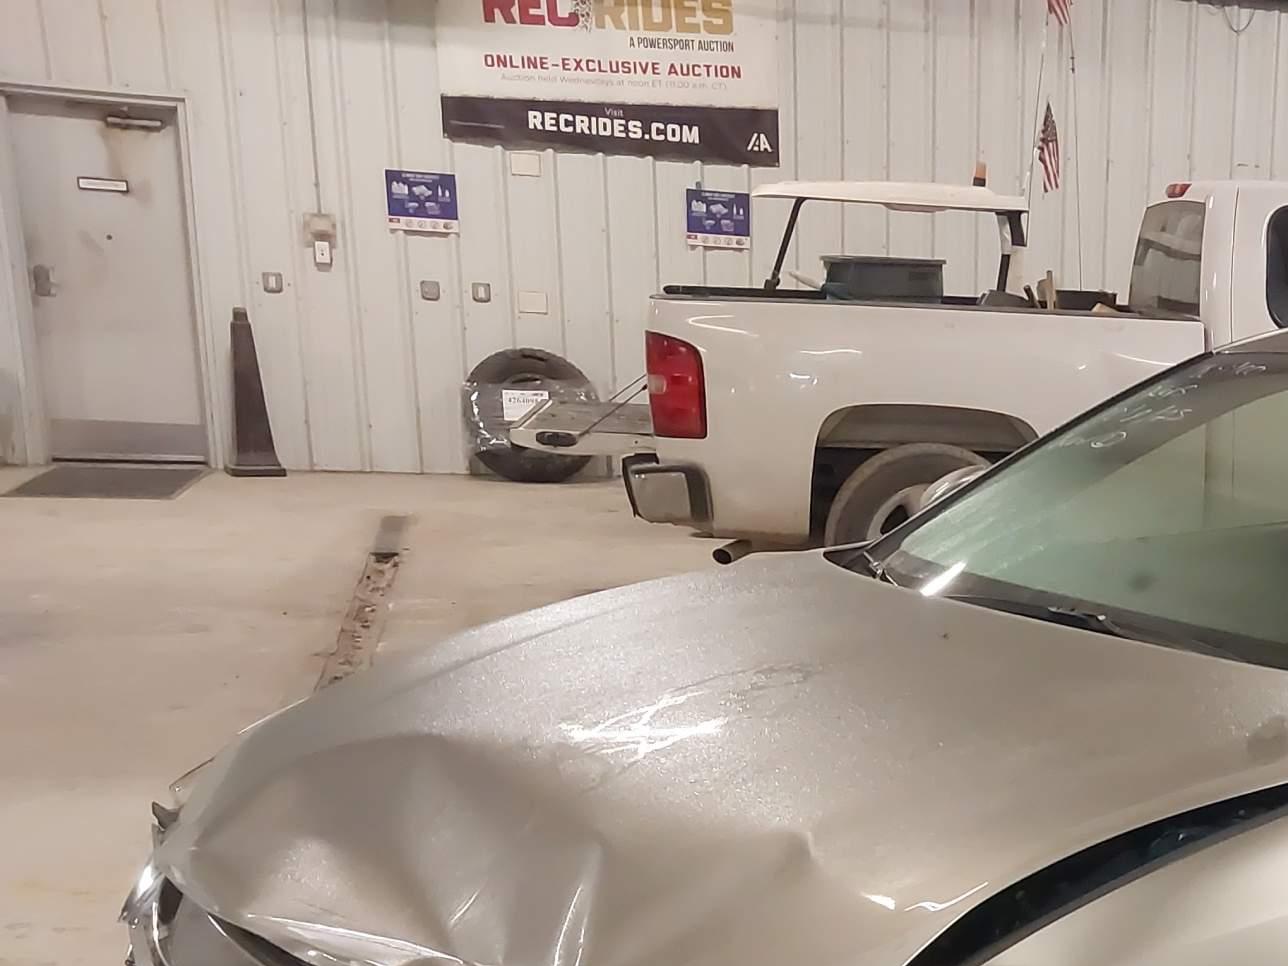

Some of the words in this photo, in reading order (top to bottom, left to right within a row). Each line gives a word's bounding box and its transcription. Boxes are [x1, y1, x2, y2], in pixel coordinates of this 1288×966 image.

[593, 0, 733, 35] RIDES
[629, 36, 635, 48] A
[637, 37, 695, 51] POWERSPORT
[697, 40, 734, 52] AUCTION
[484, 54, 660, 75] ONLINE-EXCLUSIVE
[667, 63, 742, 79] AUCTION
[604, 107, 623, 117] Visit
[528, 110, 699, 144] RECRIDES.COM
